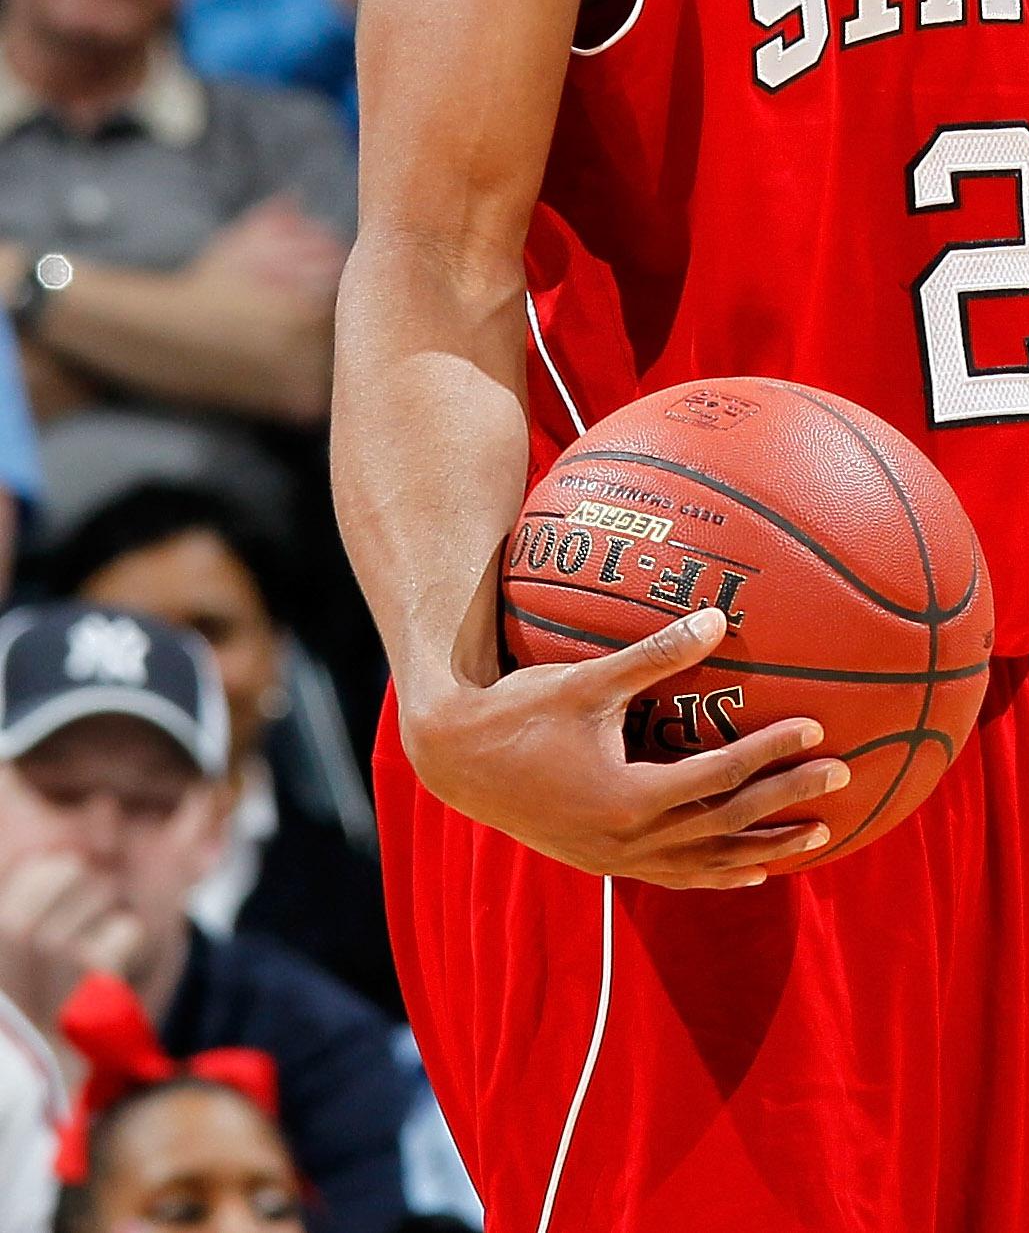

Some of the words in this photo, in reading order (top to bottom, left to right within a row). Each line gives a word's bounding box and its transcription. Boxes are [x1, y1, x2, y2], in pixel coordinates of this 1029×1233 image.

[601, 484, 673, 510] CHANNEL
[567, 500, 674, 543] LEGACY
[680, 504, 726, 526] DEEP
[510, 522, 748, 628] TF-1000
